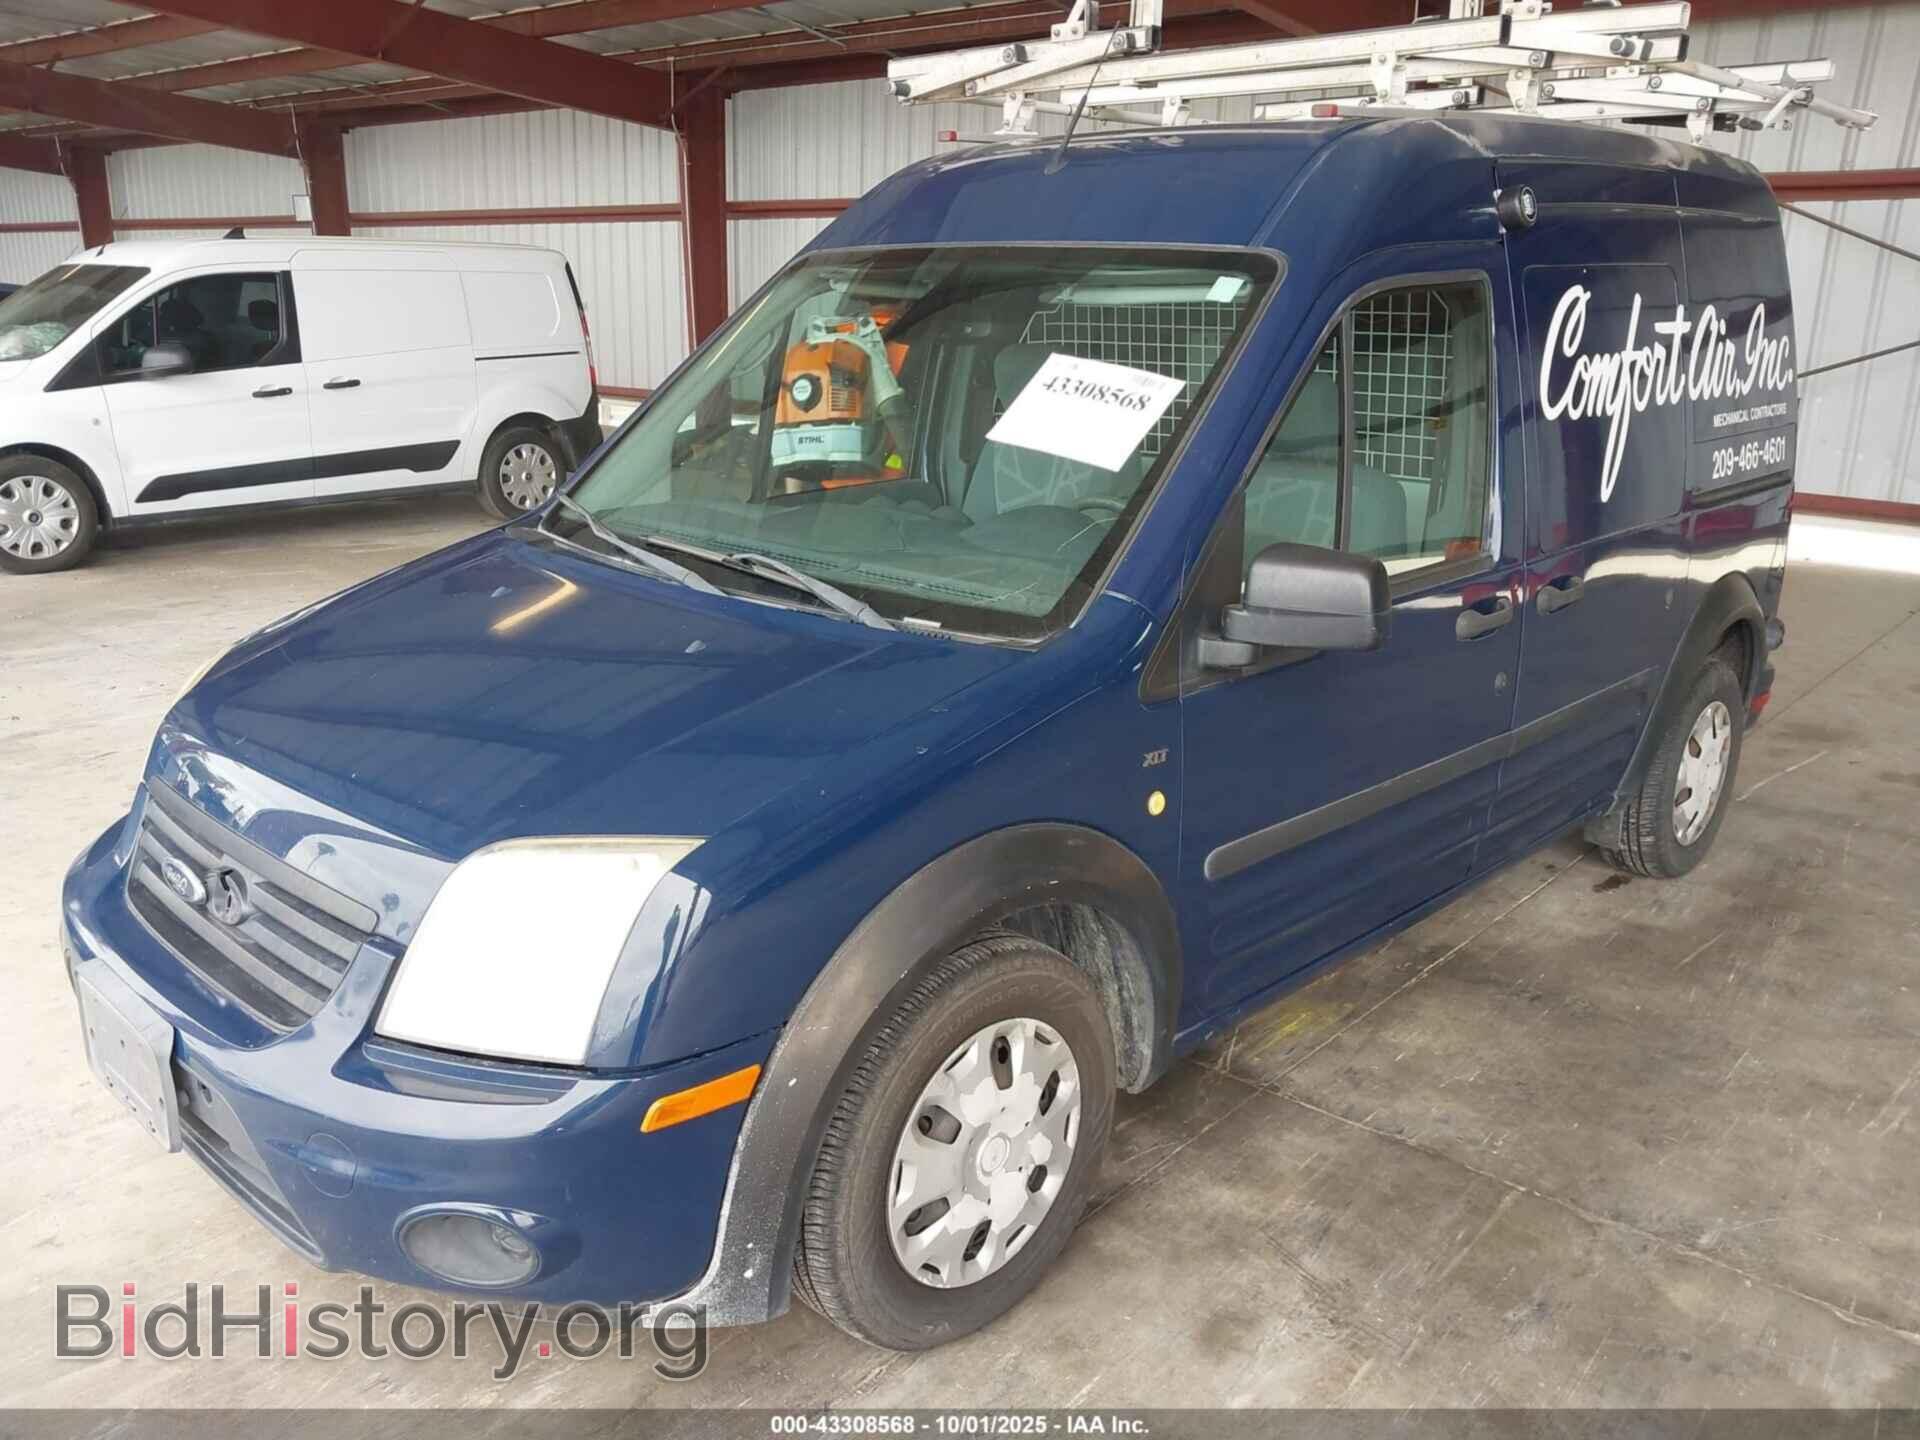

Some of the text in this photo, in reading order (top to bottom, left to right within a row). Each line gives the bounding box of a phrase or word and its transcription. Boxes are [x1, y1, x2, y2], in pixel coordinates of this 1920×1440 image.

[1043, 376, 1151, 411] 43308568
[1540, 284, 1692, 503] Comfort
[1713, 402, 1787, 427] MECHANICAL CONTRACTORS
[798, 434, 824, 445] STIHL
[1712, 436, 1786, 480] 209-466-4601
[1142, 748, 1168, 767] XLT
